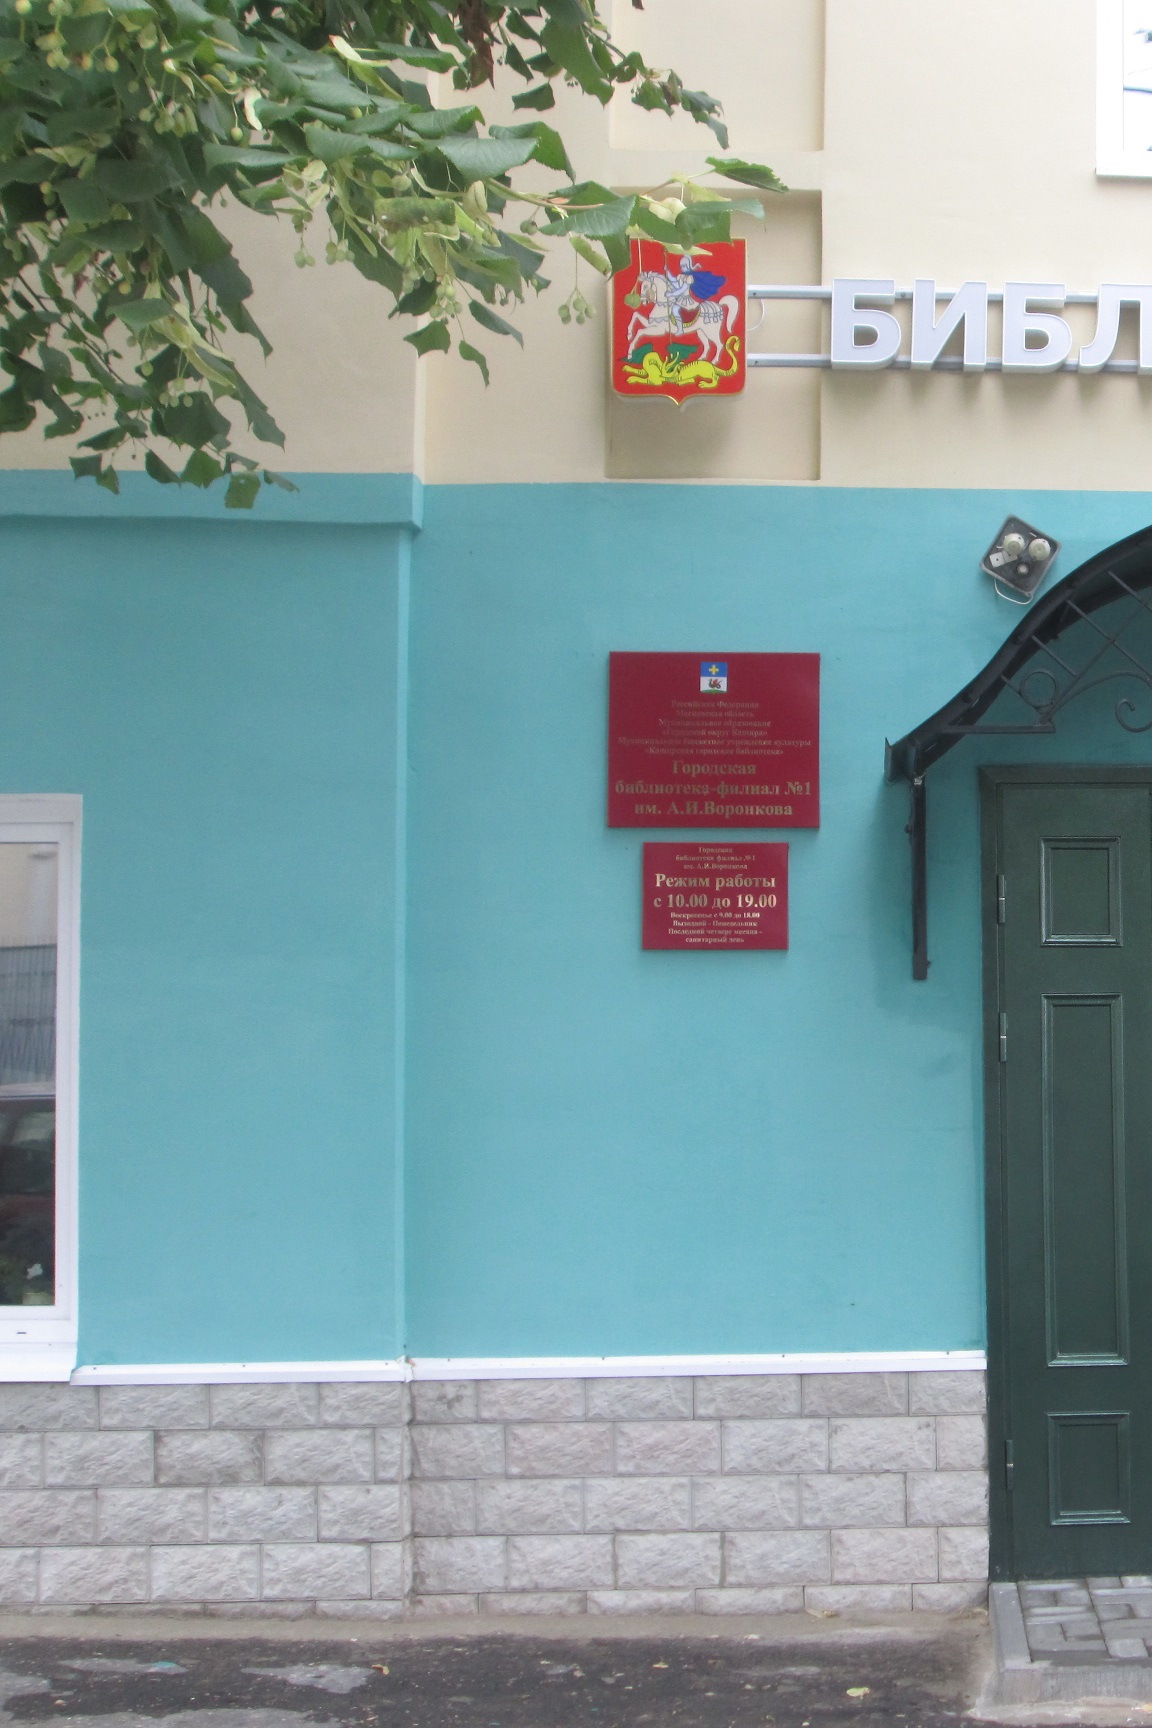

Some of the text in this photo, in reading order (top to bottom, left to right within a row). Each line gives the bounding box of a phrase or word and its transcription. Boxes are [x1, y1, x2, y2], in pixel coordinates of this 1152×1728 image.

[672, 761, 756, 777] Городская
[615, 780, 811, 798] библиотека-филиал №1
[635, 801, 793, 819] им. А.И.Воронкова
[656, 873, 776, 891] Режим работы
[654, 894, 777, 909] с 10.00 до 19.00
